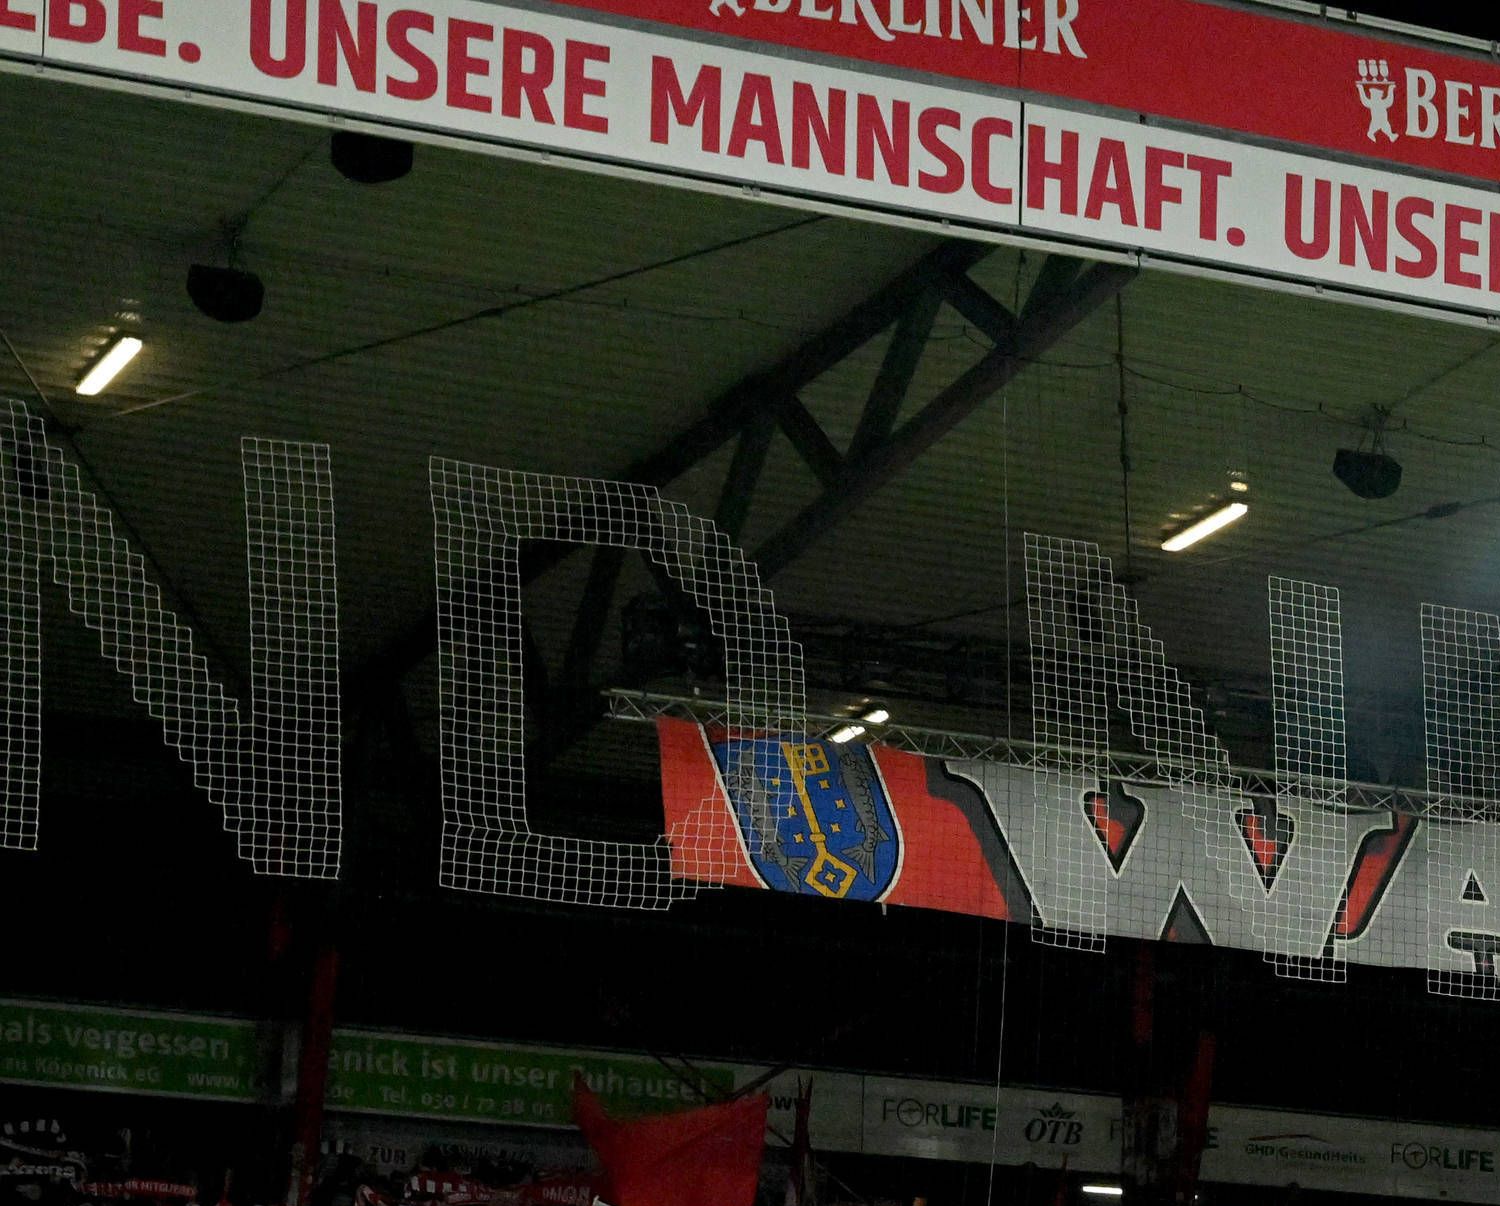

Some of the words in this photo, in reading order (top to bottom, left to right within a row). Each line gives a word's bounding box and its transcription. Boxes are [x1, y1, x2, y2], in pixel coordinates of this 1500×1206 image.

[249, 0, 610, 135] UNSERE
[650, 55, 1246, 247] MANNSCHAFT.
[421, 1047, 458, 1079] ist
[471, 1060, 560, 1091] unser
[1024, 1116, 1085, 1146] OTB
[1391, 1142, 1495, 1172] FORLIFE
